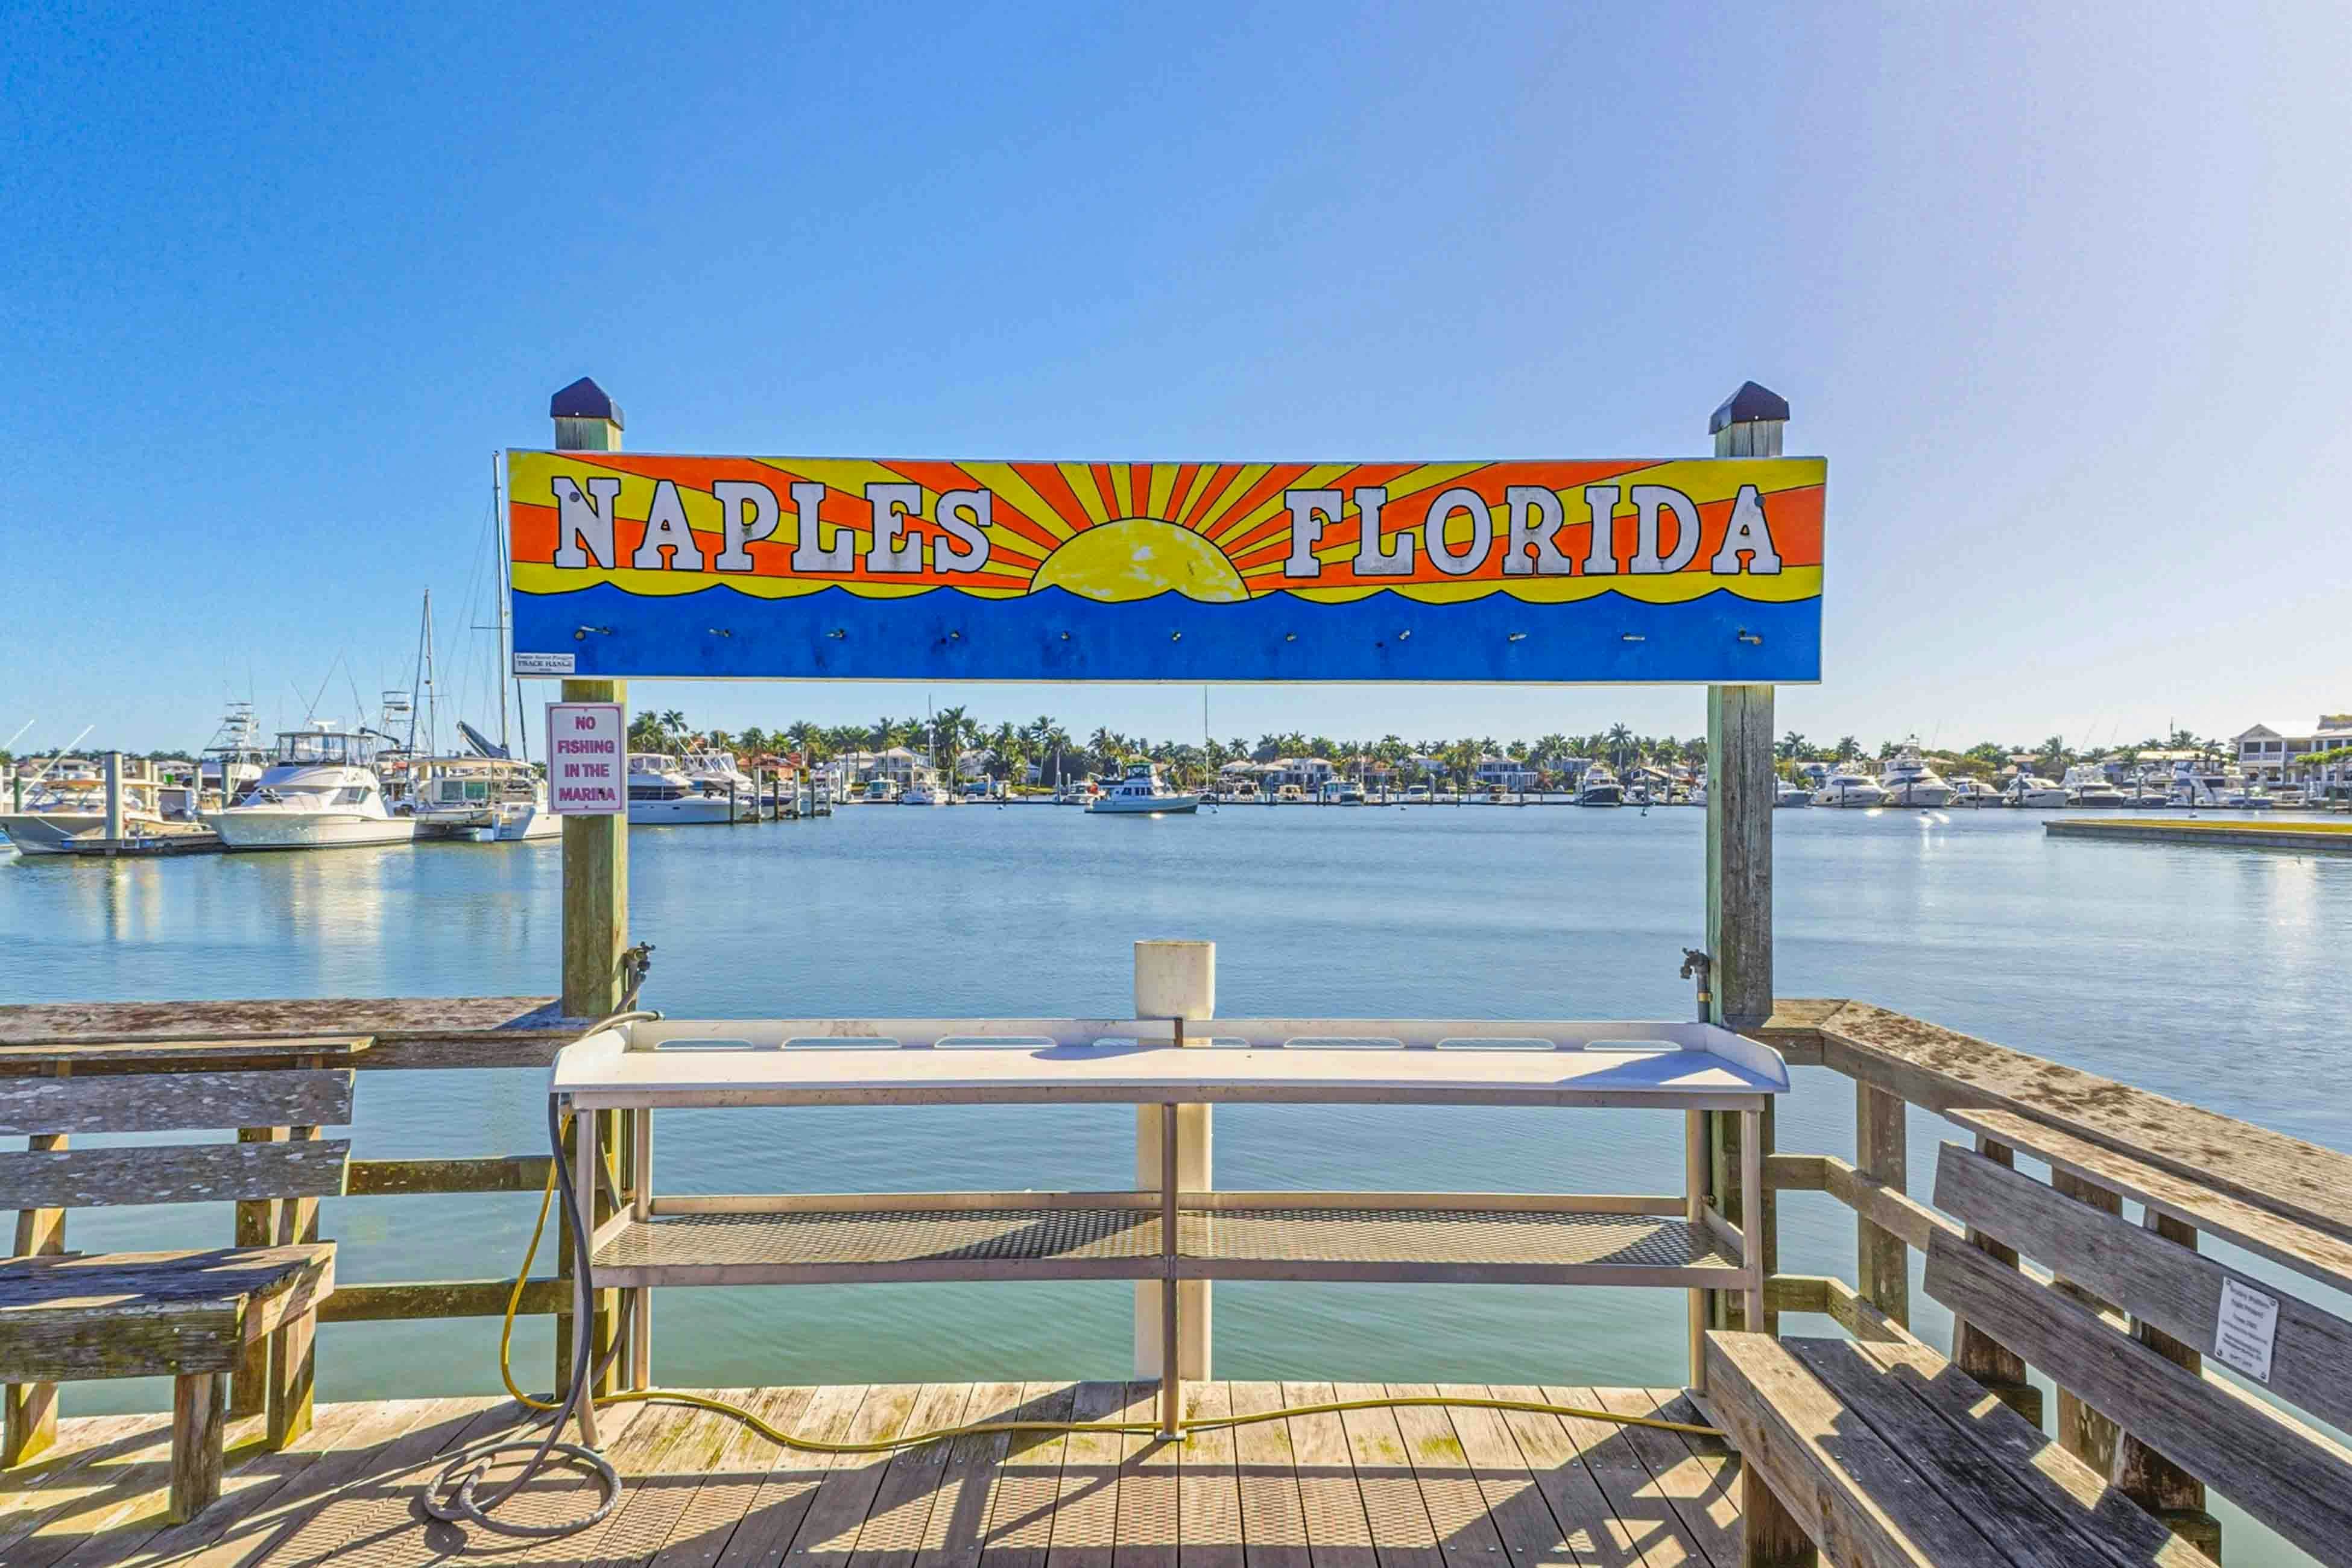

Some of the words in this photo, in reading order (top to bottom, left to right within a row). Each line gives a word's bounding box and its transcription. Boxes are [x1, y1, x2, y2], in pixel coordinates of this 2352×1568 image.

[551, 476, 993, 574] NAPLES
[1285, 484, 1782, 577] FLORIDA
[575, 716, 596, 730] NO
[557, 740, 615, 754] FISHING
[564, 763, 580, 777] IN
[583, 763, 609, 777] THE
[559, 787, 615, 801] MARINA
